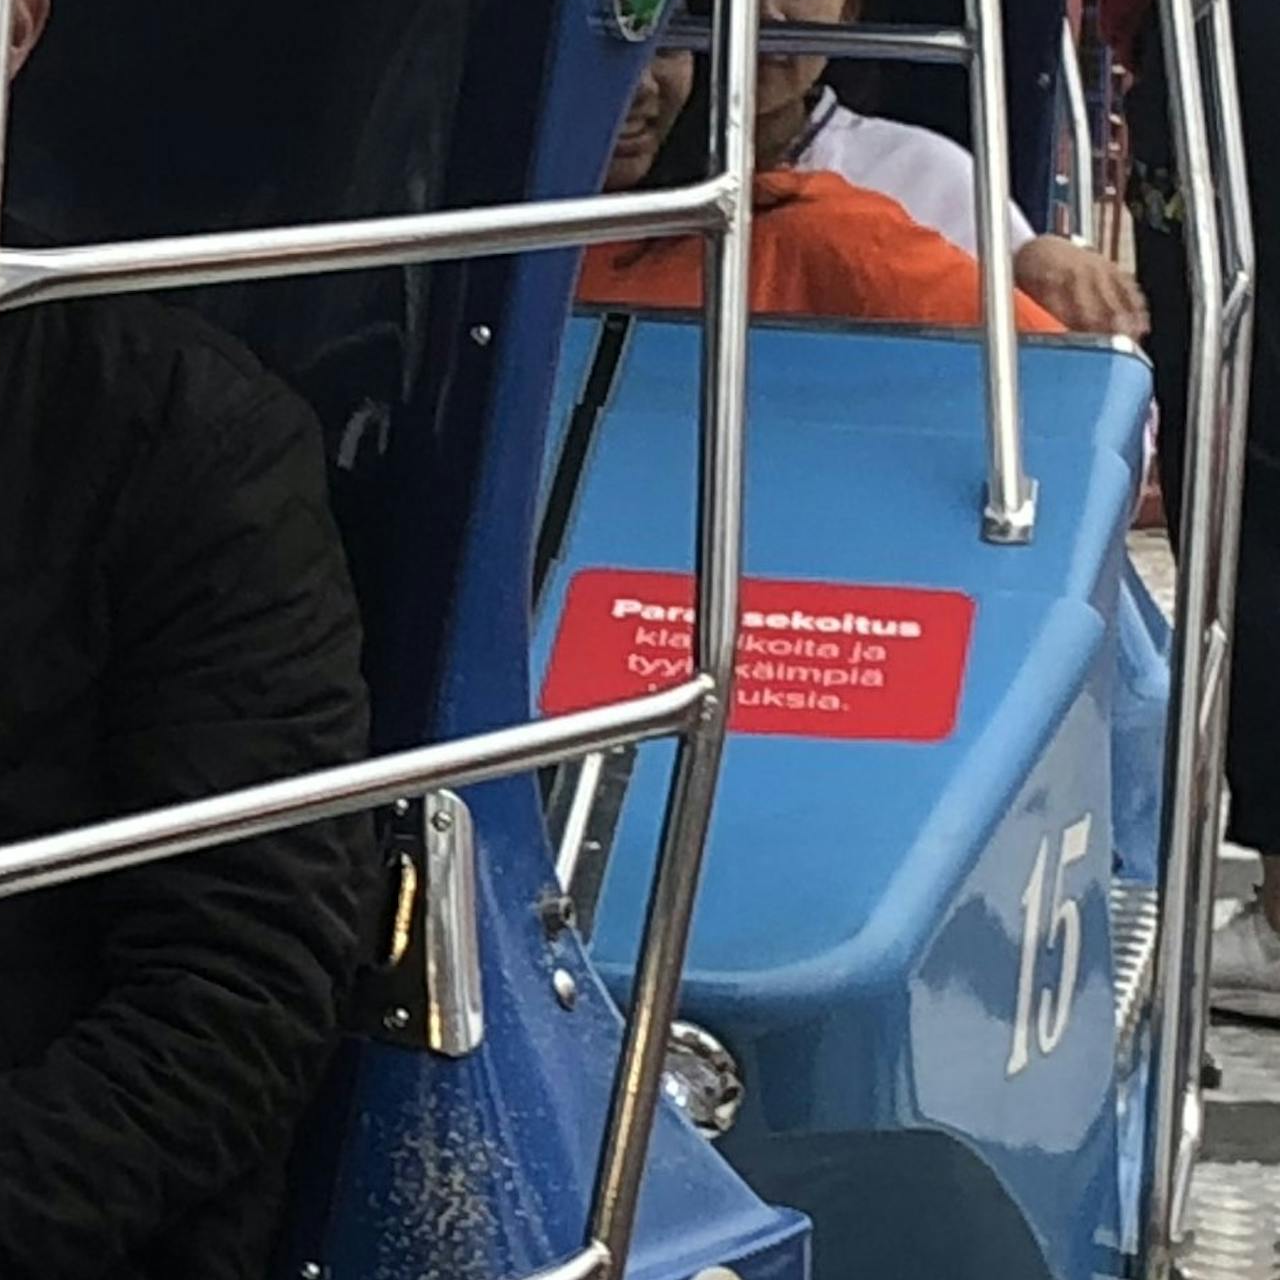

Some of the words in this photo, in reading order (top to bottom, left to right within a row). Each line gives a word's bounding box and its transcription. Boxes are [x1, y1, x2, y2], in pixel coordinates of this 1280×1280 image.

[741, 611, 922, 638] sekoitus
[634, 626, 840, 658] klaikoita
[848, 641, 887, 663] ja
[1005, 812, 1092, 1076] 15
